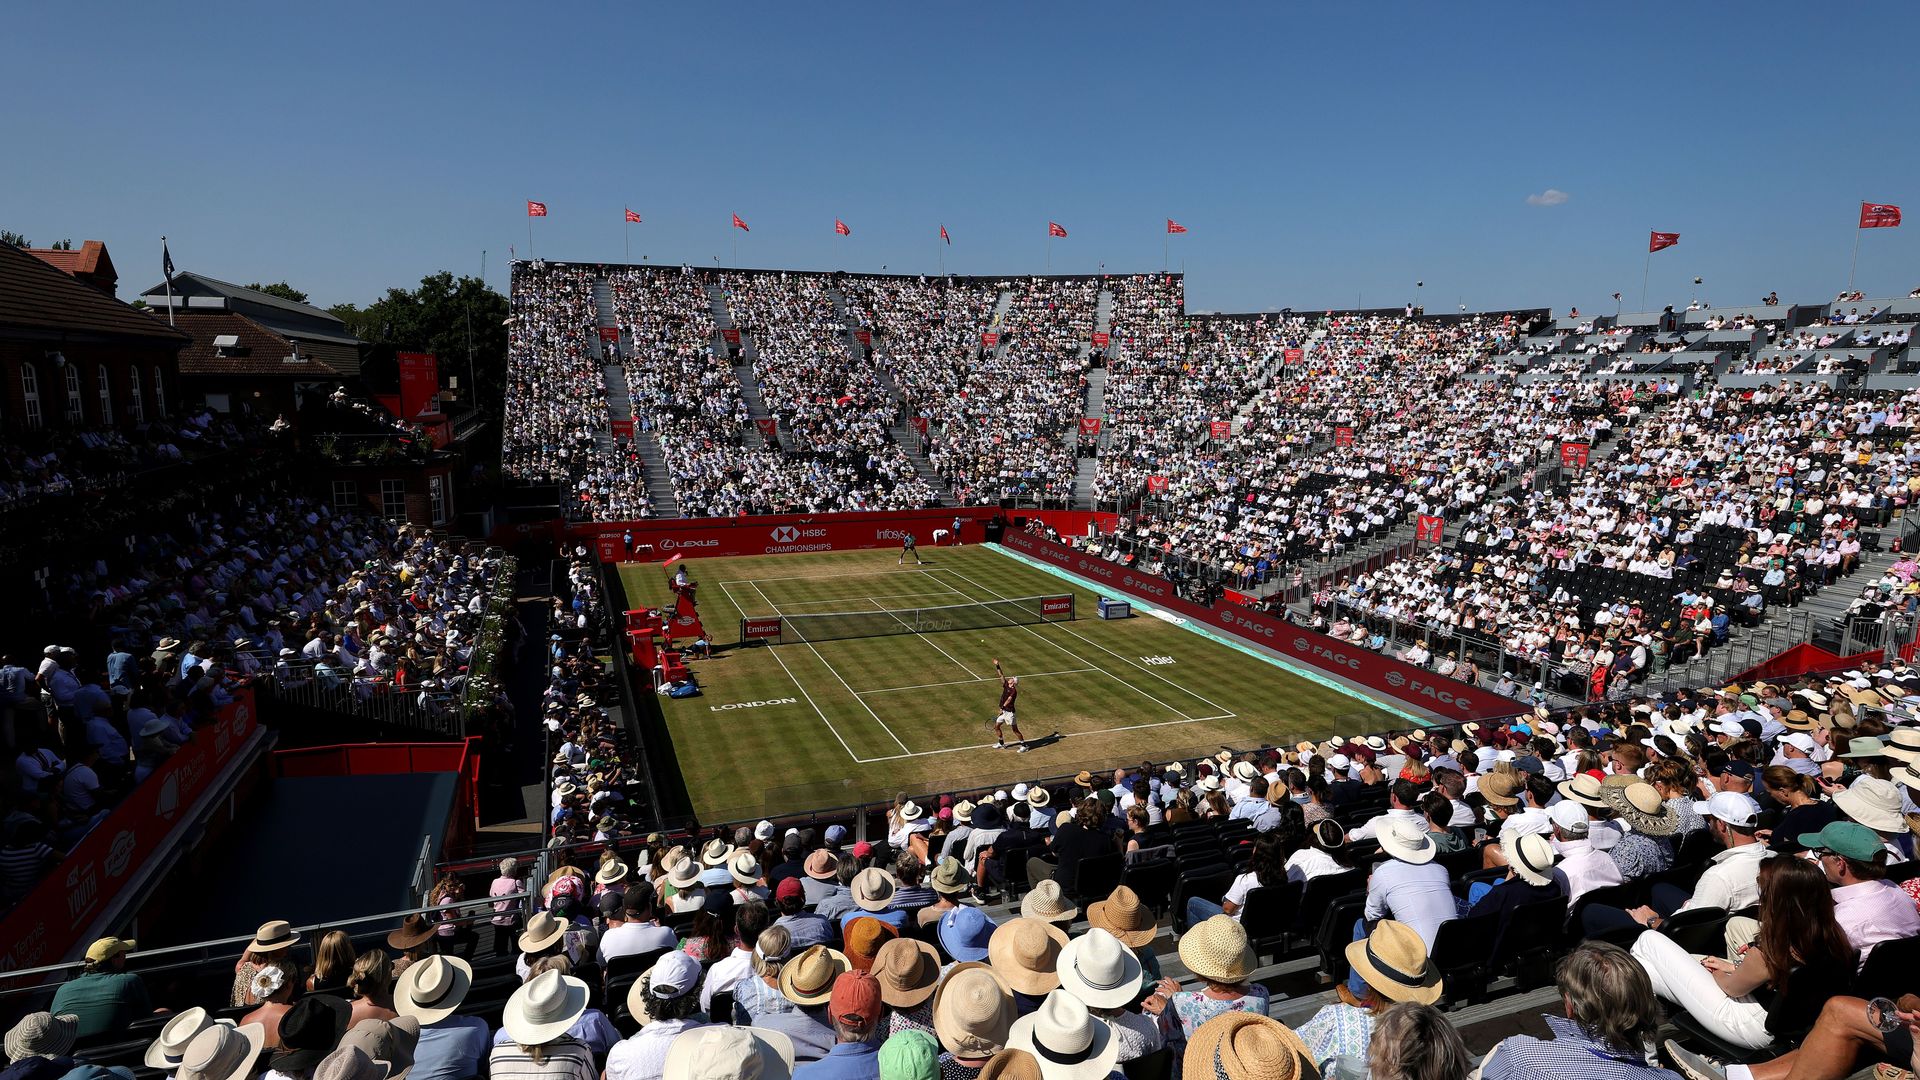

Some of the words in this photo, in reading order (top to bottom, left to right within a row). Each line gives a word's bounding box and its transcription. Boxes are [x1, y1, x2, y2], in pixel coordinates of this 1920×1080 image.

[802, 529, 827, 537] HSBC
[876, 529, 906, 541] Infosys
[676, 540, 720, 548] LEXUS
[765, 543, 832, 554] CHAMPIONSHIPS
[1014, 538, 1033, 549] FAGE
[1048, 550, 1071, 563] FAGE
[1088, 564, 1113, 578] FAGE
[1134, 580, 1164, 596] FAGE
[1043, 602, 1070, 611] Emirates
[747, 625, 779, 634] Emirates
[1236, 616, 1275, 638] FAGE
[1139, 654, 1177, 666] Haier
[1312, 645, 1361, 670] FAGE
[1410, 680, 1473, 711] FAGE
[710, 697, 797, 712] LONDON
[67, 867, 97, 919] YOUTH
[13, 920, 45, 958] Tennis
